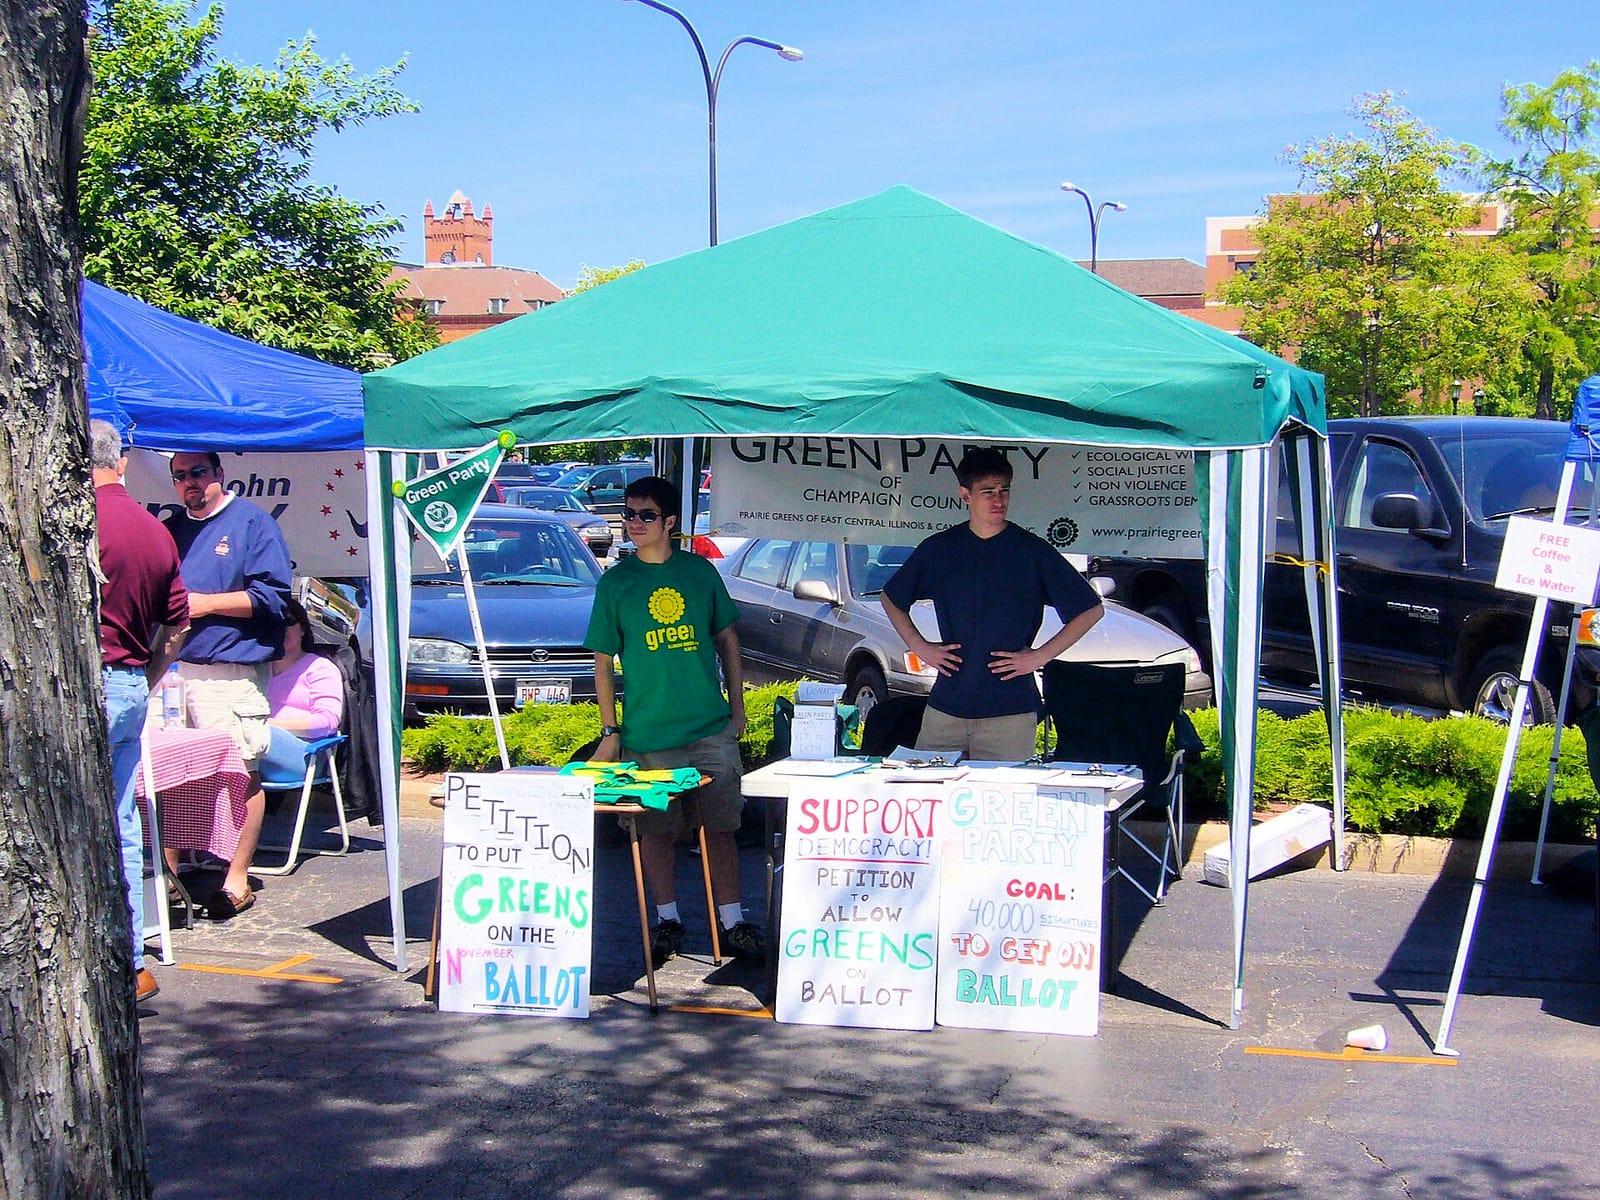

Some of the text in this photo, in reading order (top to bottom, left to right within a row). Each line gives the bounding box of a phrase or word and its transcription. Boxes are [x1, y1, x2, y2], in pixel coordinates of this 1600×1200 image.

[730, 437, 883, 471] GREEN
[1087, 451, 1171, 462] ECOLOGICAL
[405, 458, 490, 504] Green Party
[1088, 465, 1185, 477] SOCIAL JUSTICE
[227, 473, 291, 497] ohn
[880, 476, 902, 489] OF
[1088, 480, 1187, 490] NON VIOLENCE
[803, 488, 902, 506] CHAMPAIGN
[1089, 496, 1170, 506] GRASSROOTS
[739, 511, 770, 521] PRAIRIE
[772, 513, 803, 522] GREENS
[821, 515, 842, 524] EAST
[845, 517, 885, 527] CENTRAL
[889, 520, 924, 529] ILLINOIS
[927, 522, 932, 530] &
[1539, 533, 1571, 547] FREE
[1532, 547, 1571, 563] Coffee
[1544, 564, 1553, 574] &
[1516, 574, 1576, 593] Ice Water
[797, 798, 943, 838] SUPPORT
[948, 787, 1090, 833] GREEN
[447, 776, 590, 874] PETITION
[456, 845, 522, 863] TO PUT
[798, 837, 933, 858] DEMOCRACY!
[962, 827, 1079, 868] PARTY
[817, 867, 915, 889] PETITION
[851, 894, 870, 902] TO
[1006, 879, 1075, 901] GOAL:
[454, 873, 589, 929] GREENS
[821, 905, 903, 922] ALLOW
[968, 898, 1035, 933] 40,000
[488, 925, 555, 943] ON THE
[785, 928, 934, 970] GREENS
[951, 933, 1095, 971] TO GET ON
[446, 948, 514, 985] NOVEMBER
[847, 968, 867, 979] ON
[485, 962, 586, 1009] BALLOT
[801, 981, 912, 1007] BALLOT
[956, 969, 1078, 1011] BALLOT
